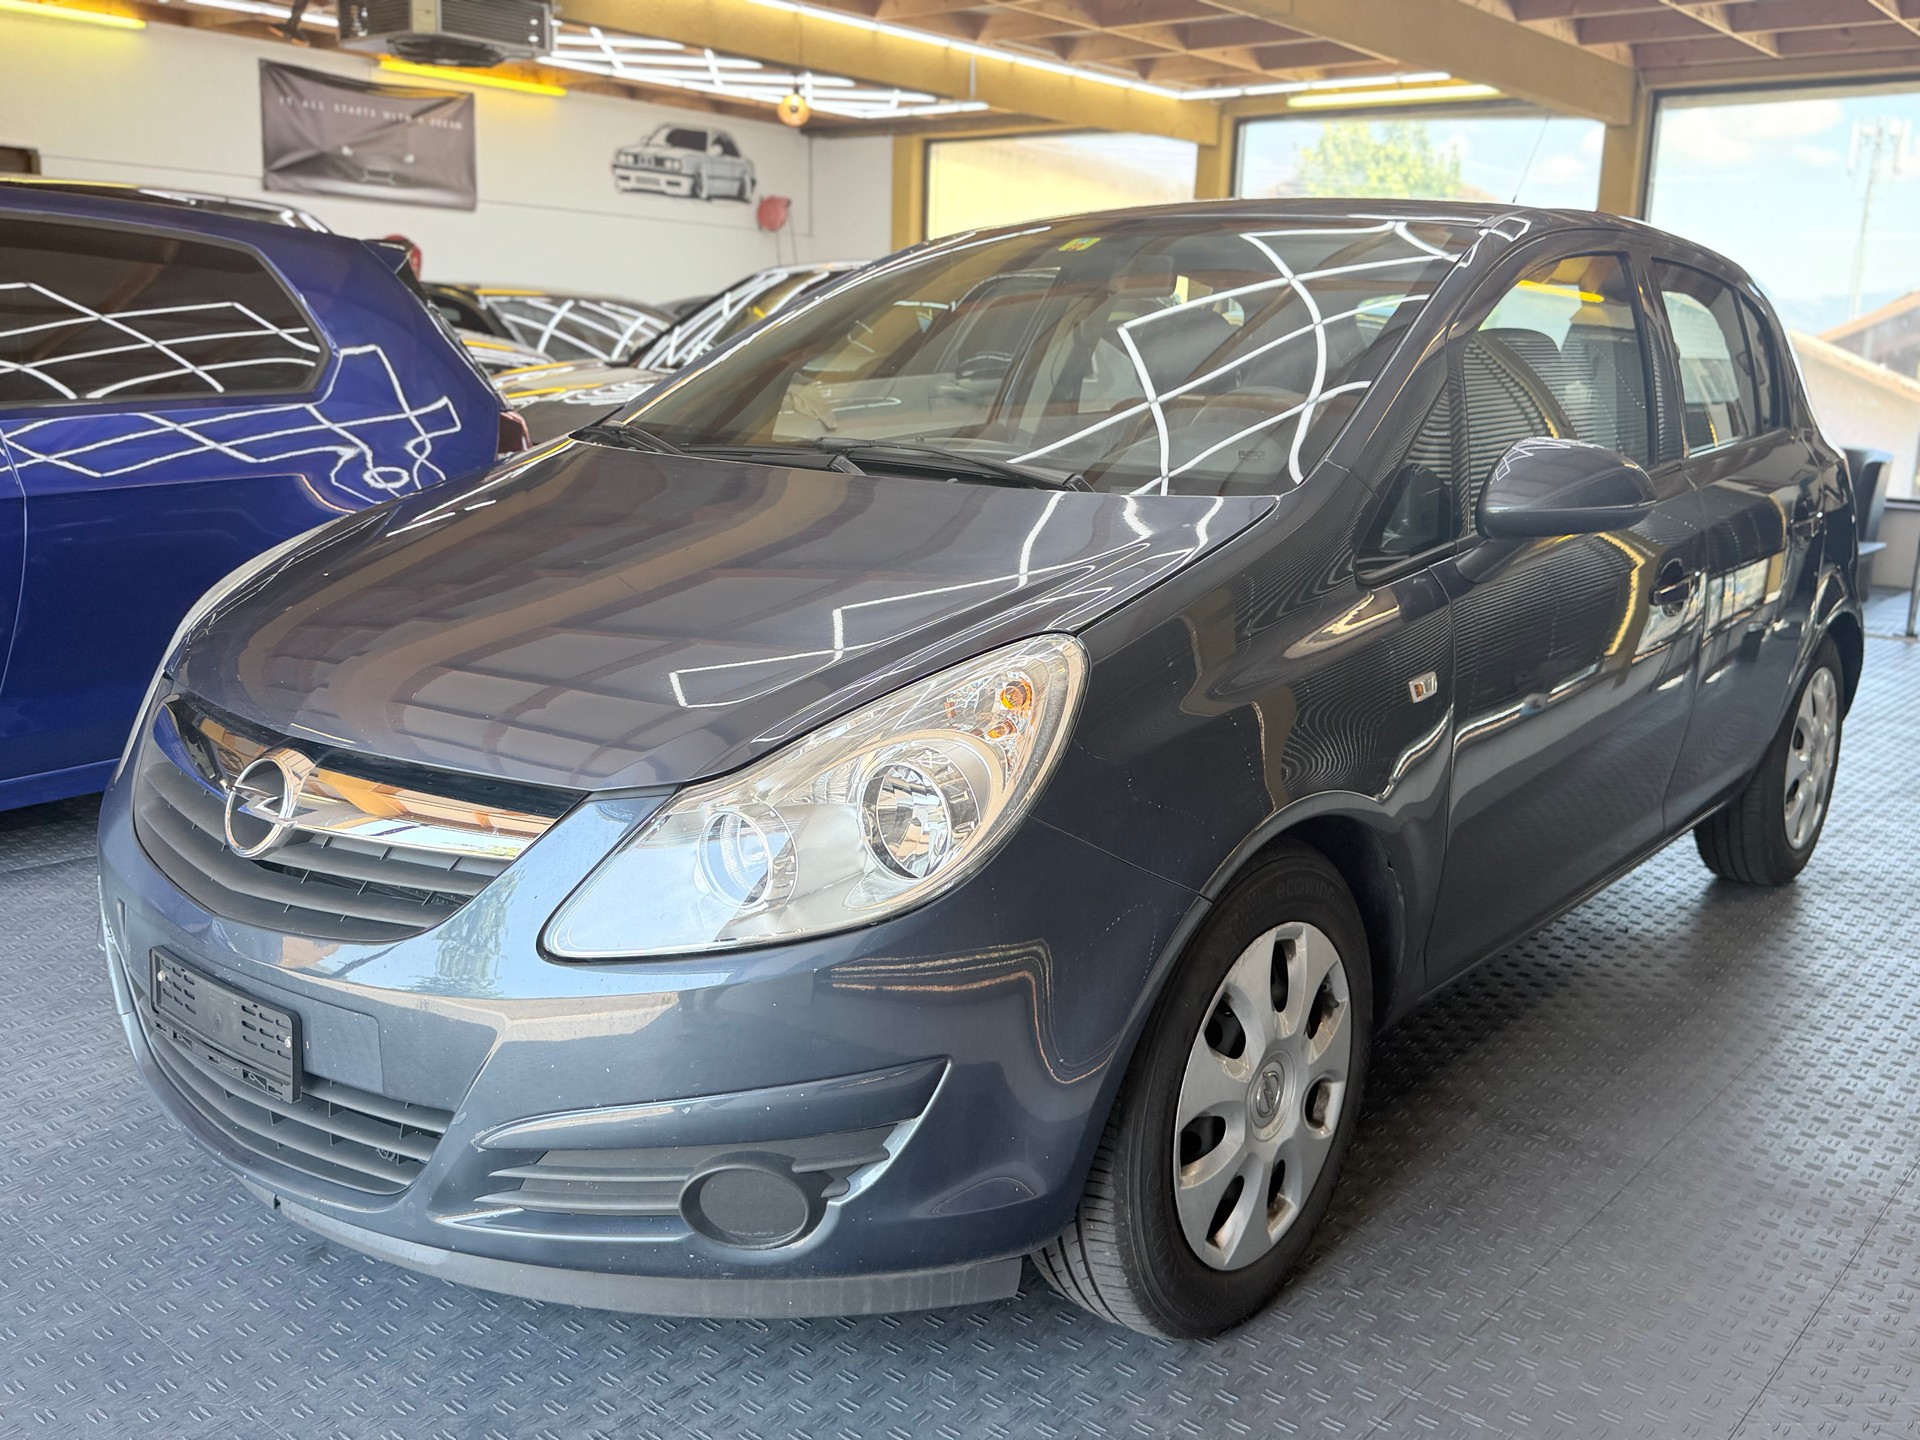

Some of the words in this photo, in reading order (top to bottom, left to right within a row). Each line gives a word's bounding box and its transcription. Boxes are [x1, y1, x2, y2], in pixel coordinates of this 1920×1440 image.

[302, 99, 325, 112] ALL
[333, 103, 377, 118] STARTS
[382, 110, 412, 124] WITH
[429, 117, 463, 131] DREAM
